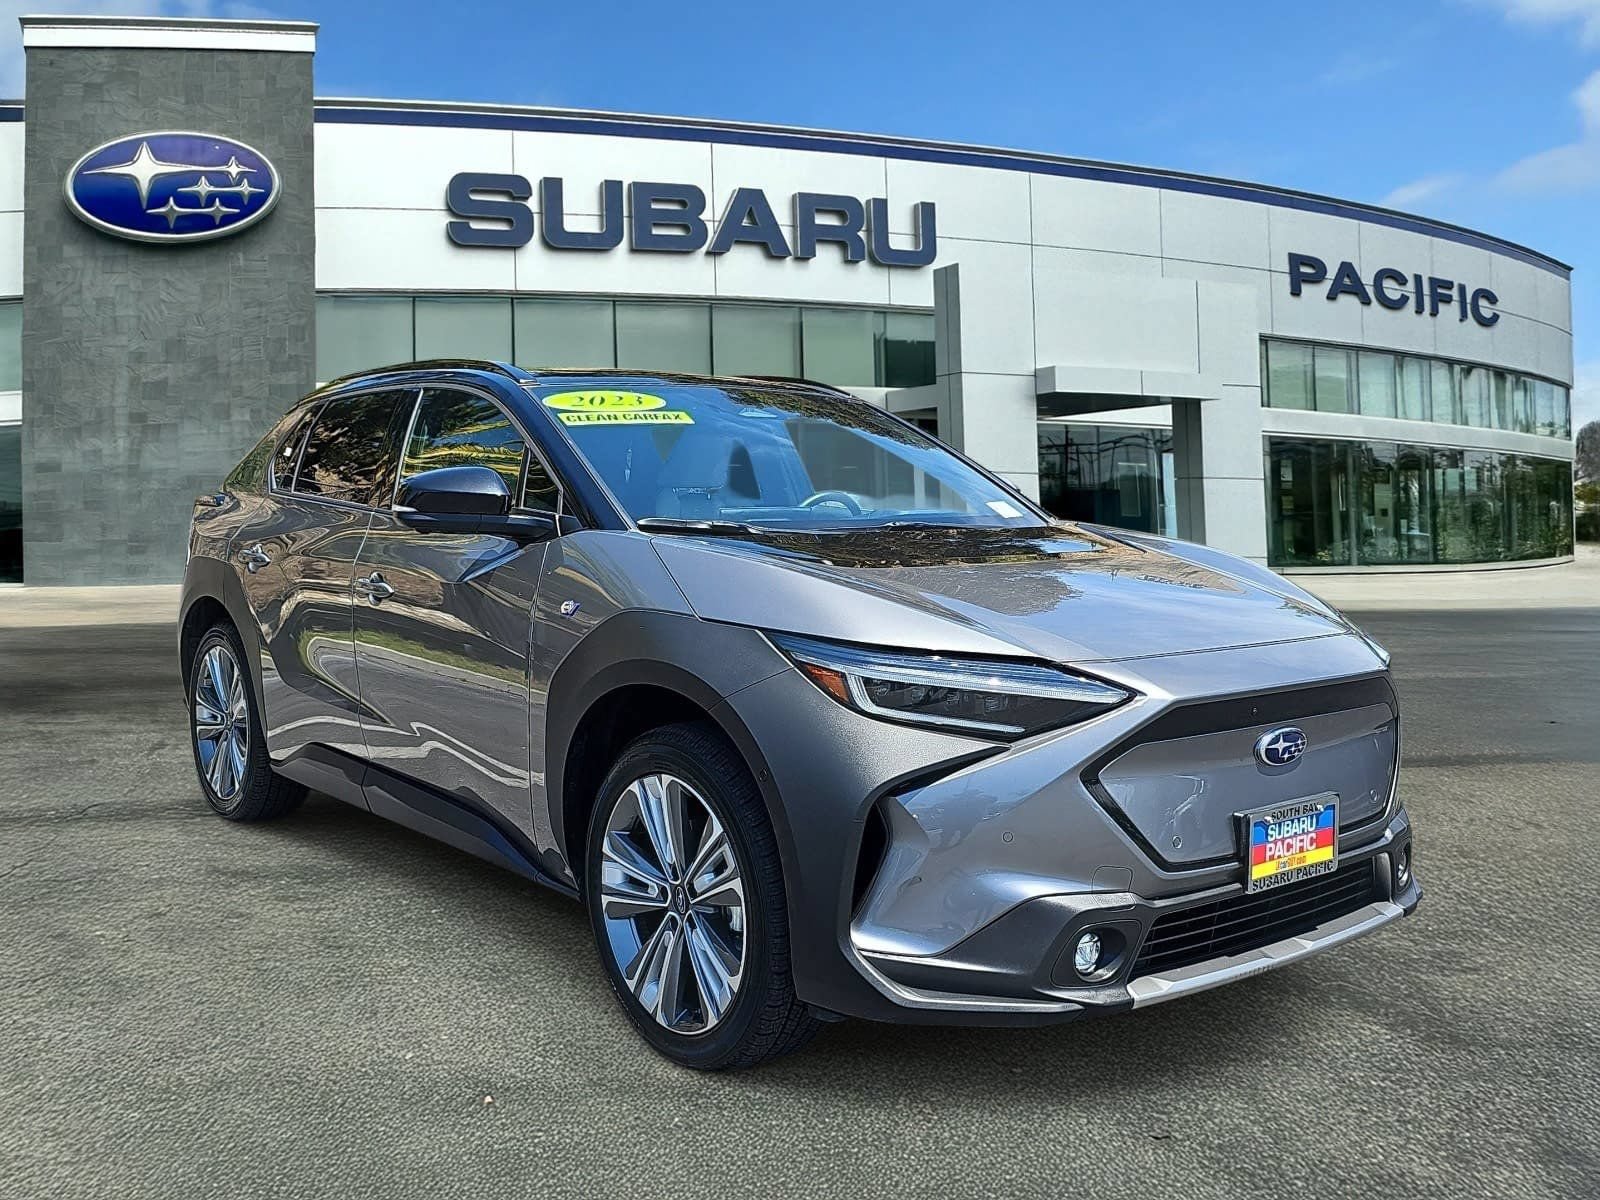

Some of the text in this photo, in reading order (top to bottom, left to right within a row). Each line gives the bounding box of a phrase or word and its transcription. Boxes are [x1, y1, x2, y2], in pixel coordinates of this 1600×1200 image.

[446, 172, 937, 268] SUBARU
[1288, 252, 1500, 327] PACIFIC
[570, 395, 643, 407] 2023
[566, 412, 682, 423] CLEAN CARFAX
[1271, 805, 1300, 822] SOUTH
[1267, 815, 1317, 841] SUBARU
[1265, 832, 1317, 861] PACIFIC
[1252, 860, 1334, 891] SUBARU PACIFIC
